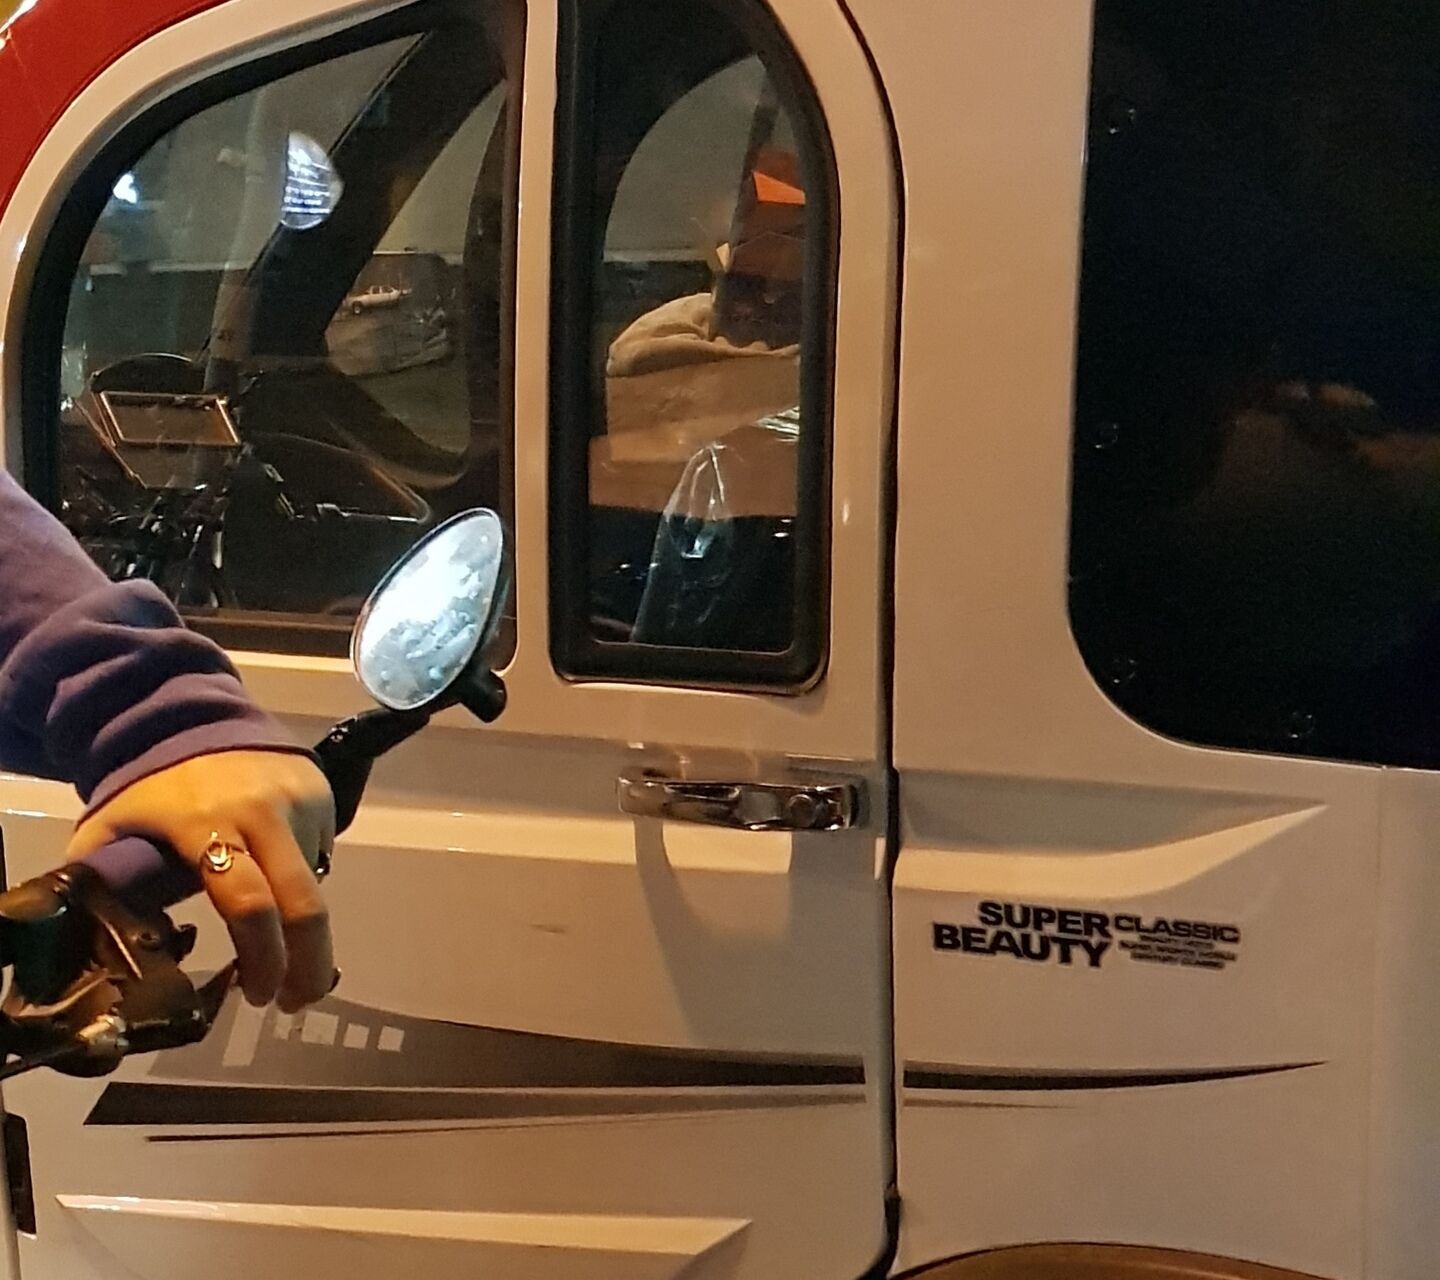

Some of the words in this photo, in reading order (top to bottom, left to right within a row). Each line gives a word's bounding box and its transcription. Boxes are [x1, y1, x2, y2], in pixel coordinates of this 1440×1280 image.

[978, 901, 1112, 939] SUPER
[1114, 914, 1240, 944] CLASSIC
[932, 922, 1110, 969] BEAUTY
